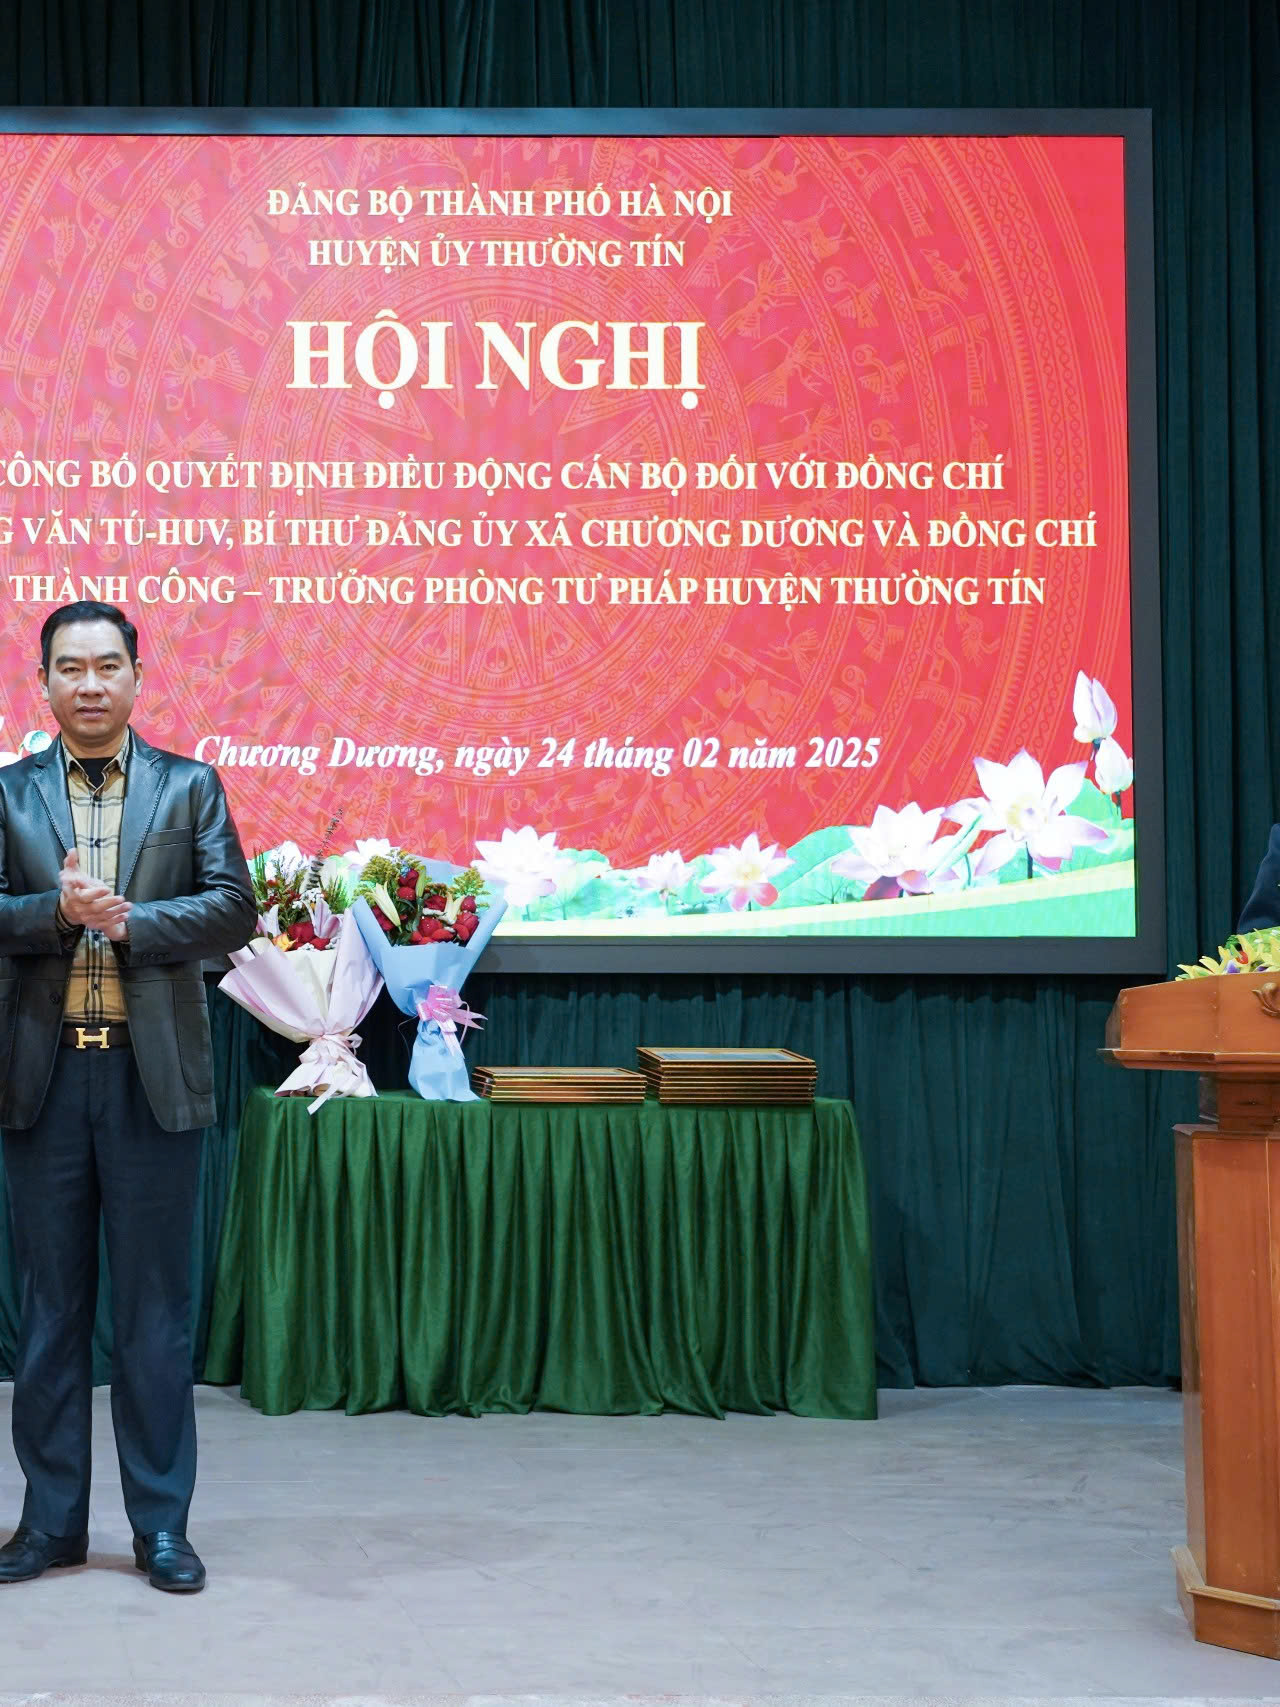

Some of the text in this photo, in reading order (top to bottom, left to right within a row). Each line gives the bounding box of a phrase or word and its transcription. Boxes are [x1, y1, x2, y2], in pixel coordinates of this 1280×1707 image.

[266, 181, 733, 223] ĐẢNG BỘ THÀNH PHỐ HÀ NỘI
[307, 232, 685, 274] HUYỆN ỦY THƯỜNG TÍN
[285, 308, 706, 410] HỘI NGHỊ
[89, 451, 137, 489] BỐ
[145, 452, 263, 494] QUYẾT
[269, 461, 356, 497] ĐỊNH
[363, 453, 446, 490] ĐIỀU
[453, 457, 553, 497] ĐỘNG
[560, 453, 633, 490] CÁN
[639, 457, 687, 497] BỘ
[695, 453, 758, 490] ĐỐI
[765, 452, 827, 490] VỚI
[835, 453, 934, 490] ĐỒNG
[942, 454, 1004, 490] CHÍ
[21, 509, 93, 545] VĂN
[99, 509, 234, 551] TÚ-HUV,
[241, 509, 277, 546] BÍ
[284, 511, 361, 547] THƯ
[365, 510, 463, 547] ĐẢNG
[471, 511, 519, 547] ỦY
[524, 511, 573, 547] XÃ
[581, 512, 732, 548] CHƯƠNG
[740, 512, 865, 548] DƯƠNG
[872, 511, 920, 547] VÀ
[927, 511, 1027, 548] ĐỒNG
[1035, 511, 1097, 547] CHÍ
[8, 566, 129, 603] THÀNH
[137, 566, 237, 604] CÔNG
[268, 567, 416, 605] TRƯỞNG
[423, 568, 545, 605] PHÒNG
[551, 570, 603, 605] TƯ
[608, 568, 699, 605] PHÁP
[704, 572, 823, 612] HUYỆN
[830, 569, 979, 606] THƯỜNG
[987, 568, 1046, 605] TÍN
[194, 735, 881, 777] Chương Dương, ngày 24 tháng 02 năm 2025
